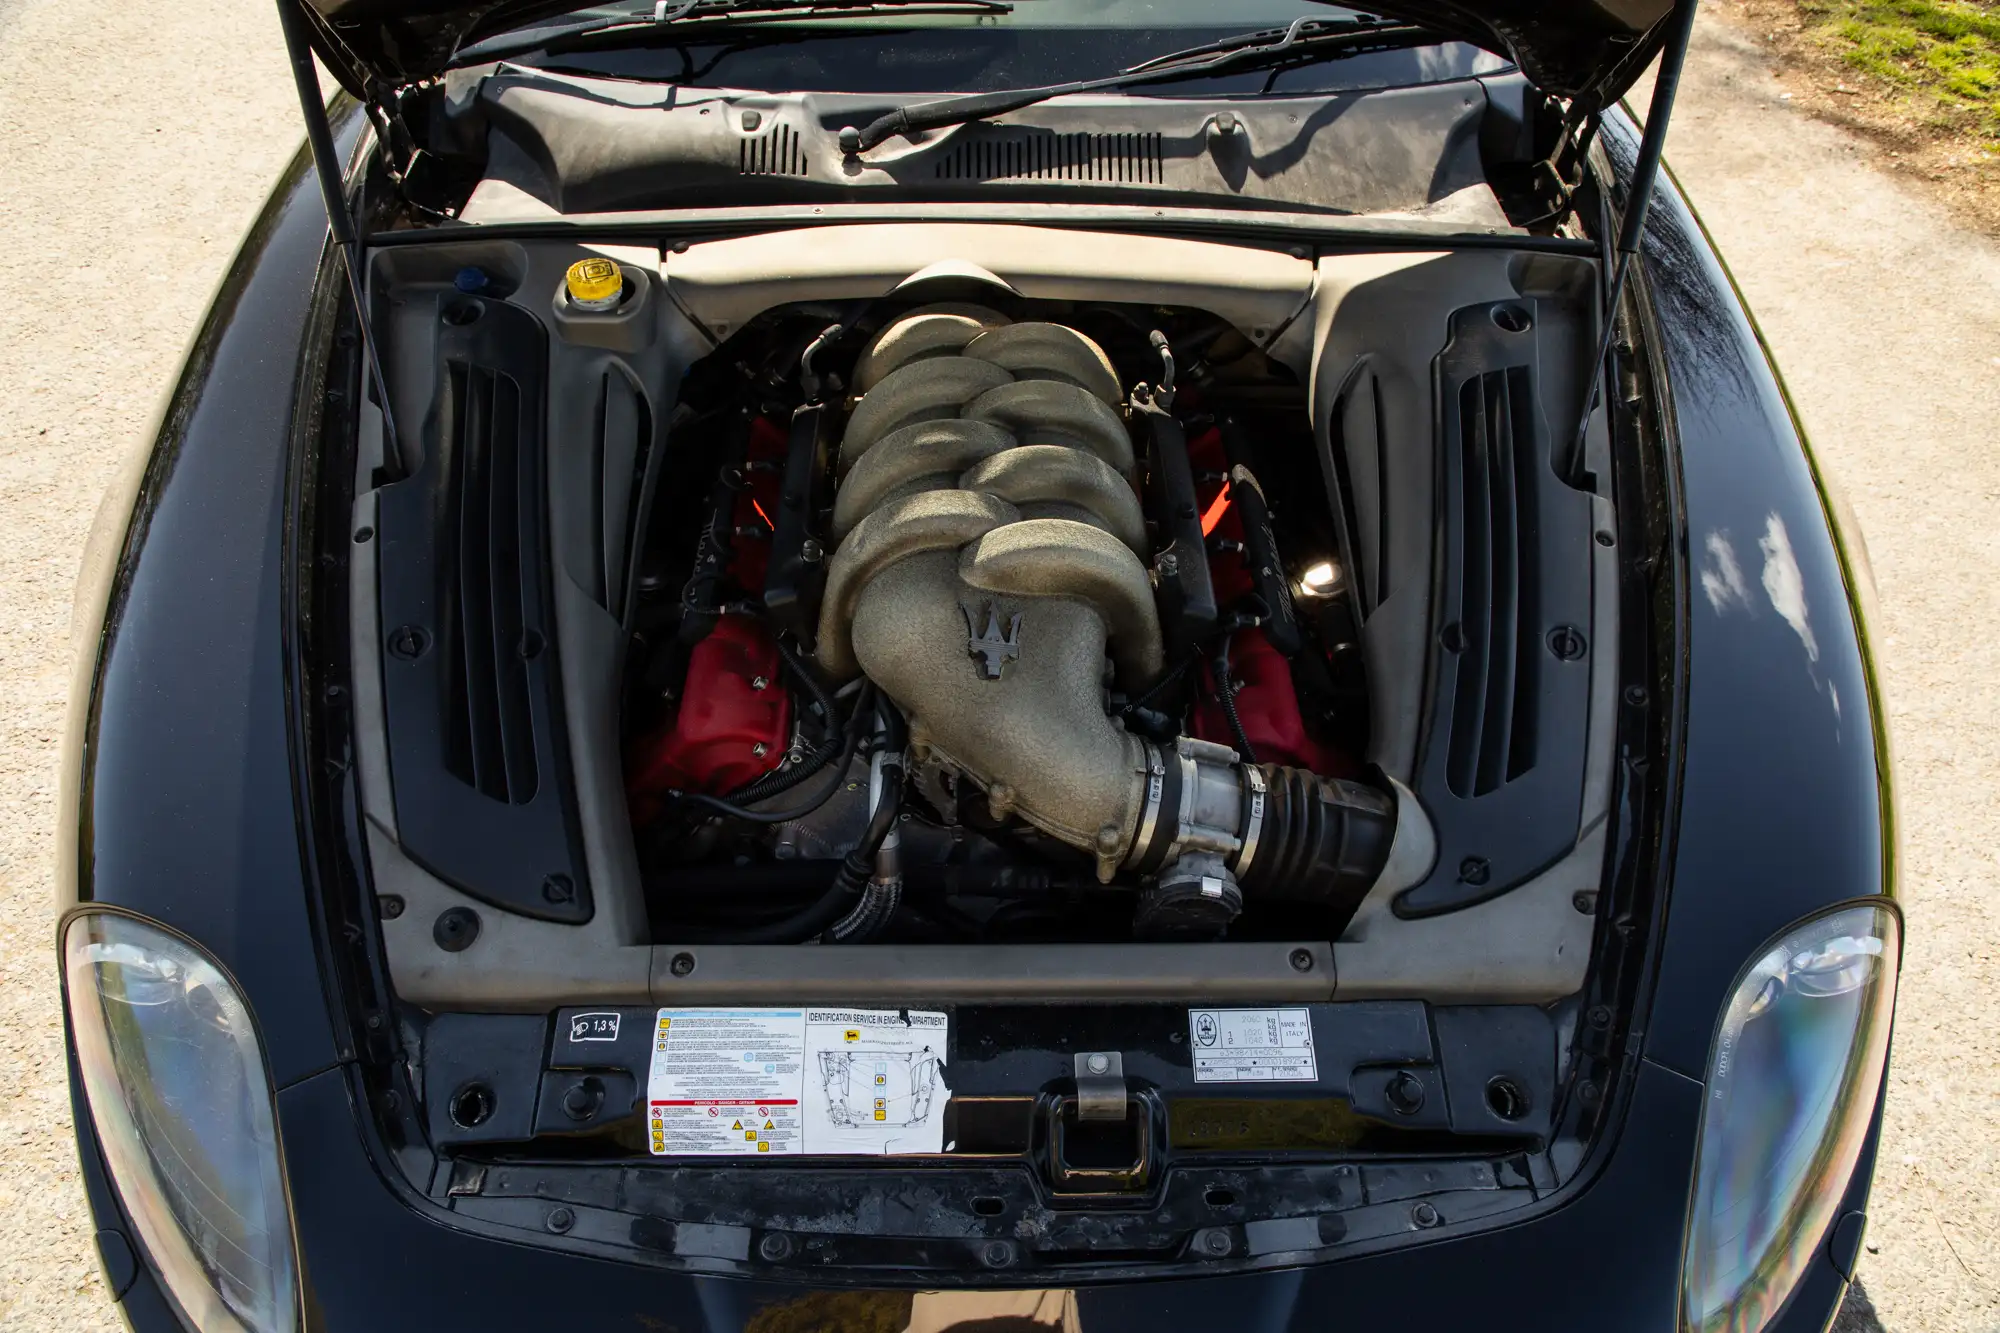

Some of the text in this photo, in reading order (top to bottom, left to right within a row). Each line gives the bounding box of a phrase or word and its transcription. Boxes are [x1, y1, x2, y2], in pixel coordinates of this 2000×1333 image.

[808, 1012, 852, 1022] IDENTIFICATION
[853, 1013, 877, 1024] SERVICE
[877, 1015, 883, 1024] IN
[908, 1015, 946, 1026] OMPARTMENT
[1267, 1017, 1276, 1025] kg
[594, 1020, 616, 1033] 1,3 %
[1268, 1030, 1278, 1038] kg
[1269, 1037, 1279, 1045] kg
